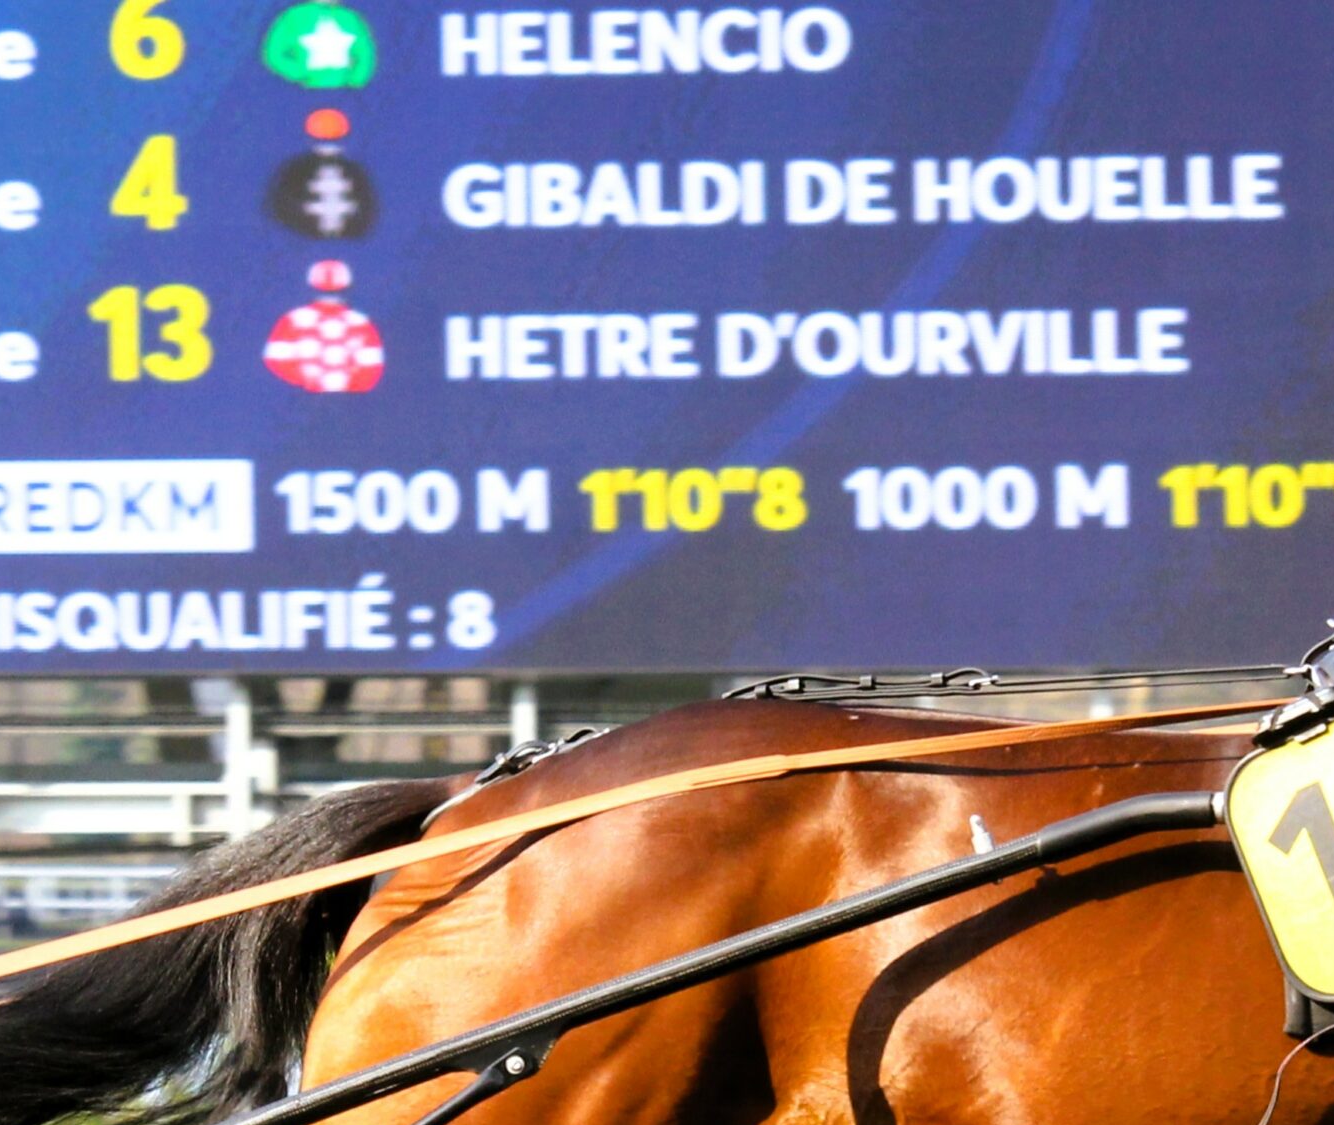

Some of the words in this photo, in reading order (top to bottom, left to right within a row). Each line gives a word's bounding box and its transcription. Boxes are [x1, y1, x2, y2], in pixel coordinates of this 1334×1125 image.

[109, 0, 185, 80] 6
[441, 7, 852, 76] HELENCIO
[110, 134, 189, 231] 4
[441, 161, 765, 228] GIBALDI
[784, 159, 897, 225] DE
[912, 154, 1285, 223] HOUELLE
[88, 284, 213, 382] 13
[445, 313, 701, 380] HETRE
[717, 308, 1191, 377] D'OURVILLE
[275, 470, 460, 534] 1500
[476, 469, 550, 532] M
[844, 466, 1039, 530] 1000
[1055, 464, 1130, 529] M
[447, 591, 496, 650] 8
